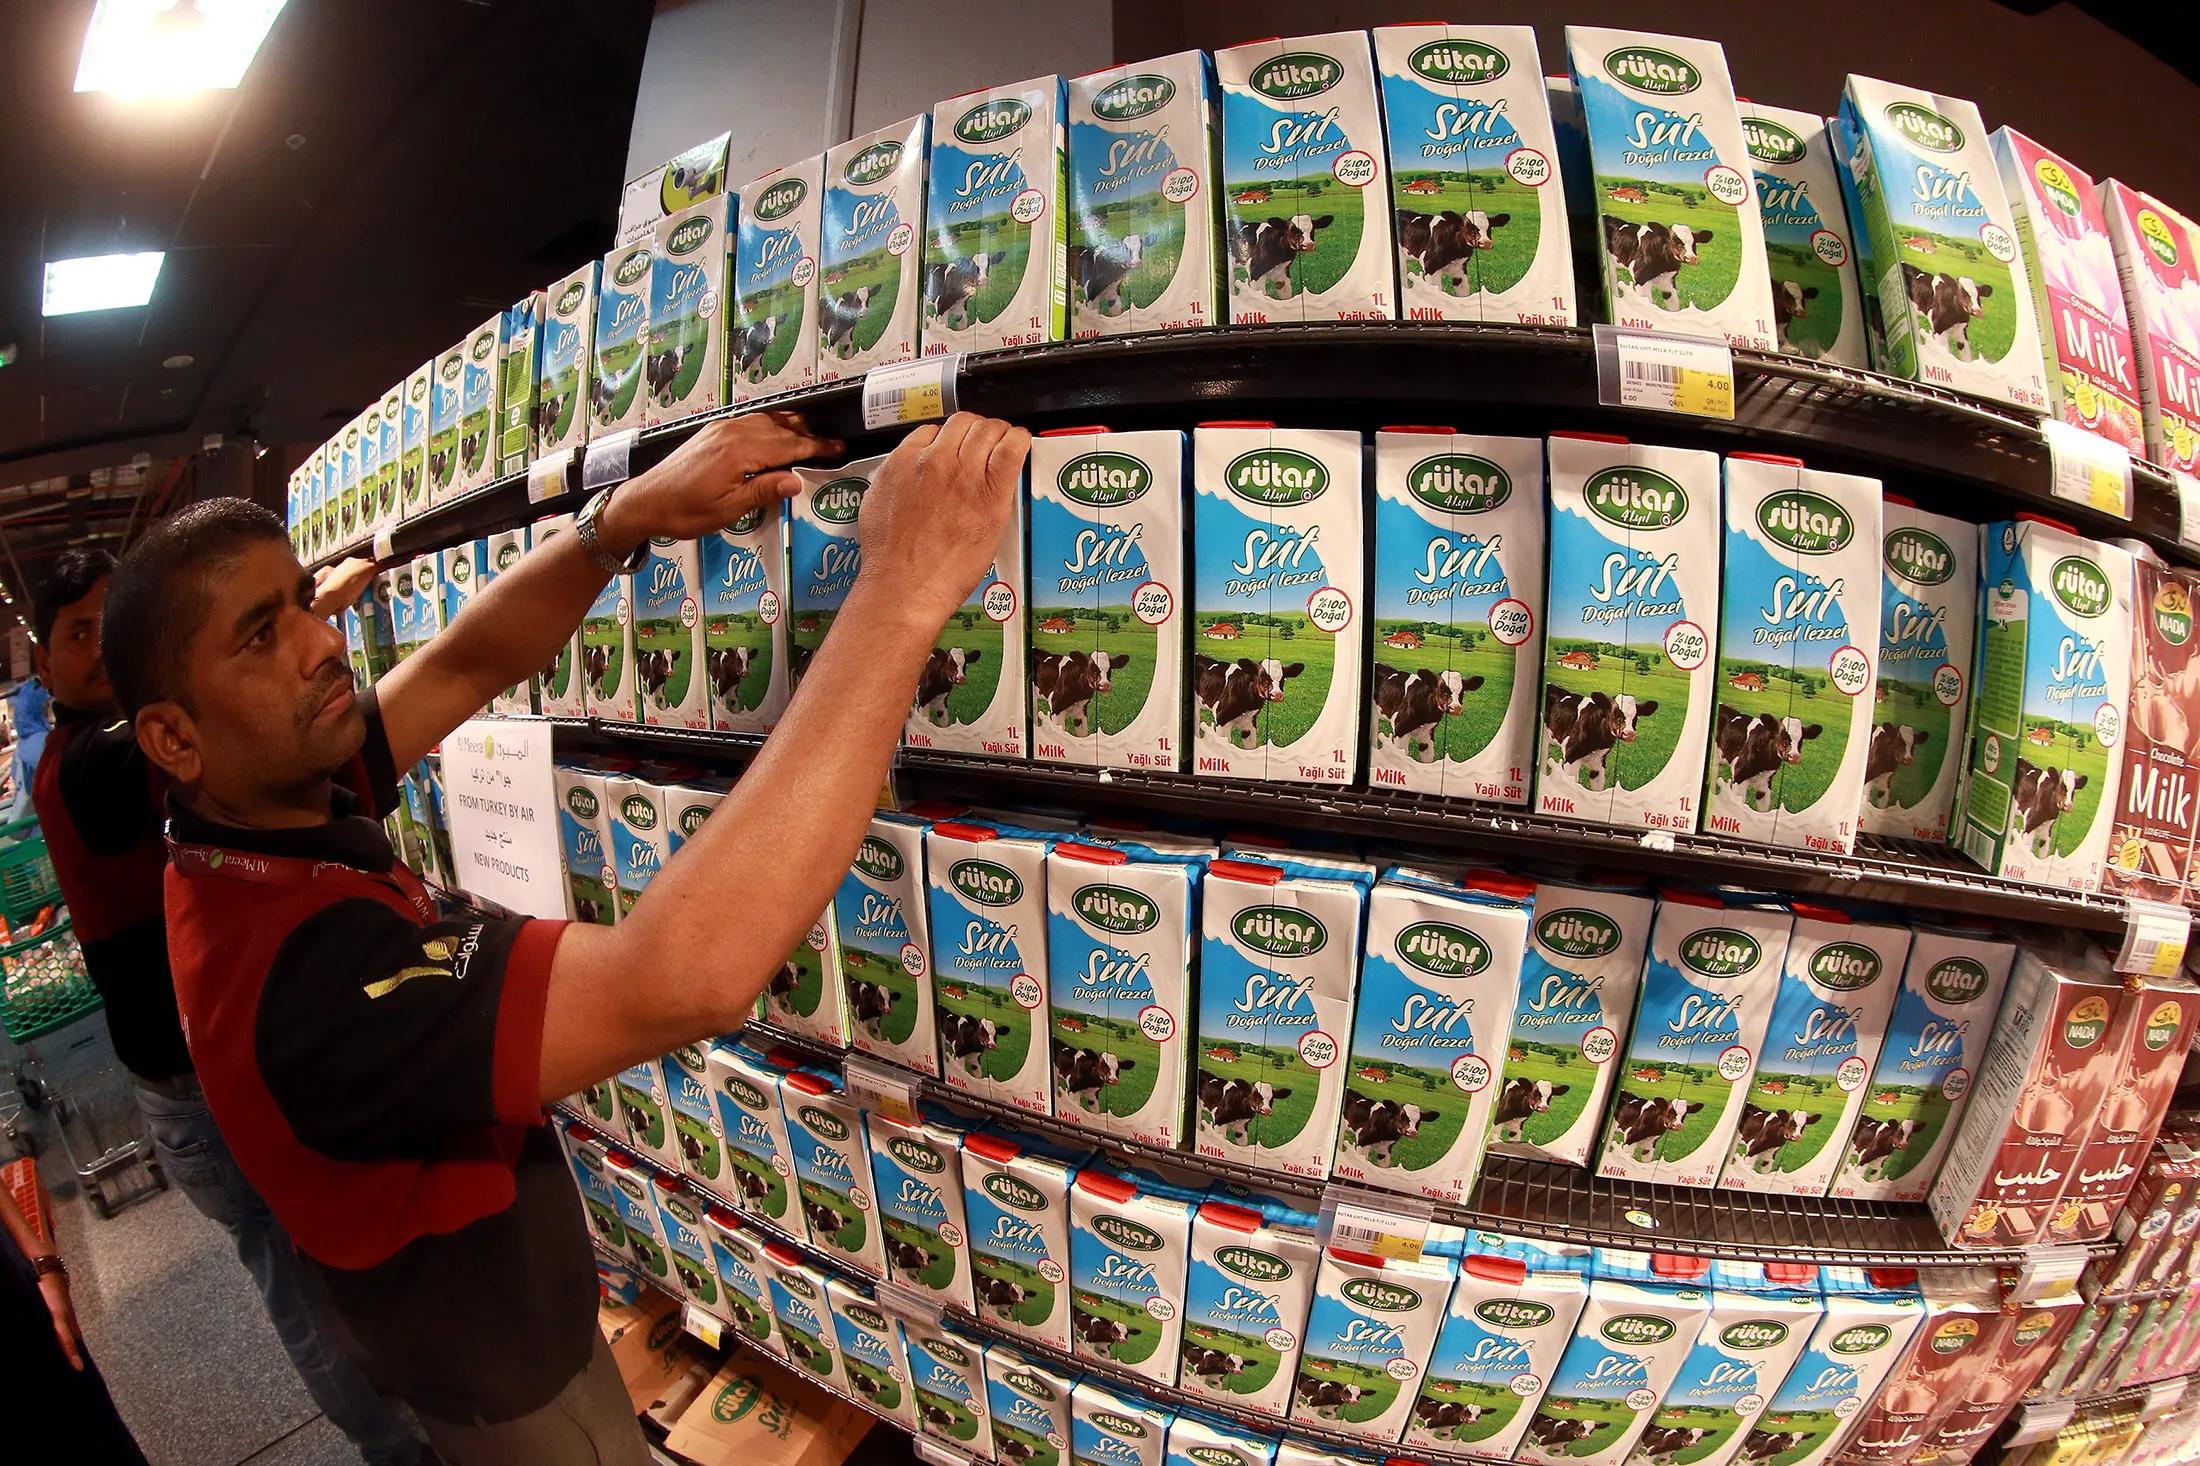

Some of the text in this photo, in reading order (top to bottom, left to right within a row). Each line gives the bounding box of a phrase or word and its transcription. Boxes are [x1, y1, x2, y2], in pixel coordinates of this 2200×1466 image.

[1425, 99, 1508, 141] Süt
[1261, 107, 1339, 153] Süt
[1625, 111, 1703, 149] Süt
[1474, 131, 1519, 149] lezzet
[1673, 148, 1715, 162] lezzet
[955, 147, 1023, 196] Süt
[1911, 165, 1972, 203] Süt
[1551, 298, 1567, 311] 1L
[2070, 295, 2113, 331] Strawberry
[1030, 318, 1040, 328] 1L
[1409, 308, 1443, 321] Milk
[924, 343, 948, 356] Milk
[2062, 308, 2133, 391] Milk
[1925, 365, 1954, 383] Milk
[2030, 376, 2043, 389] 1L
[1707, 380, 1729, 391] 4.00
[1064, 524, 1143, 573] Süt
[1232, 525, 1320, 576] Süt
[1414, 534, 1502, 584] Süt
[1105, 562, 1148, 583] lezzet
[1278, 566, 1326, 587] lezzet
[1590, 551, 1679, 602] Süt
[1459, 577, 1508, 597] lezzet
[1635, 598, 1684, 617] lezzet
[1761, 576, 1845, 624] Süt
[1803, 624, 1849, 641] lezzet
[2159, 613, 2186, 637] NADA
[2050, 636, 2105, 682] Süt
[1039, 744, 1065, 758] Milk
[1159, 738, 1170, 750] 1L
[1155, 755, 1171, 766] Süt
[1200, 758, 1230, 772] Milk
[1333, 750, 1345, 762] 1L
[2150, 747, 2184, 767] Chocolate
[1328, 768, 1345, 779] Süt
[1376, 769, 1406, 785] Milk
[1544, 796, 1574, 813] Milk
[1679, 797, 1691, 811] 1L
[2128, 763, 2191, 829] Milk
[459, 794, 535, 822] FROM TURKEY BY AIR
[1672, 816, 1690, 829] Süt
[1711, 815, 1740, 833] Milk
[1839, 822, 1849, 836] 1L
[474, 852, 529, 882] NEW PRODUCTS
[958, 921, 1017, 956] Süt
[1079, 949, 1150, 986] Süt
[1233, 974, 1315, 1012] Süt
[1273, 1012, 1317, 1026] lezzet
[1391, 994, 1476, 1033] Süt
[2068, 1025, 2096, 1040] NADA
[2147, 1028, 2170, 1042] NADA
[1200, 1144, 1225, 1157] Milk
[1313, 1156, 1322, 1165] 1L
[1339, 1165, 1364, 1179] Milk
[1603, 1165, 1626, 1176] Milk
[1994, 1151, 2062, 1196] حليب
[2078, 1148, 2135, 1193] حليب
[1857, 1426, 1922, 1454] حليب
